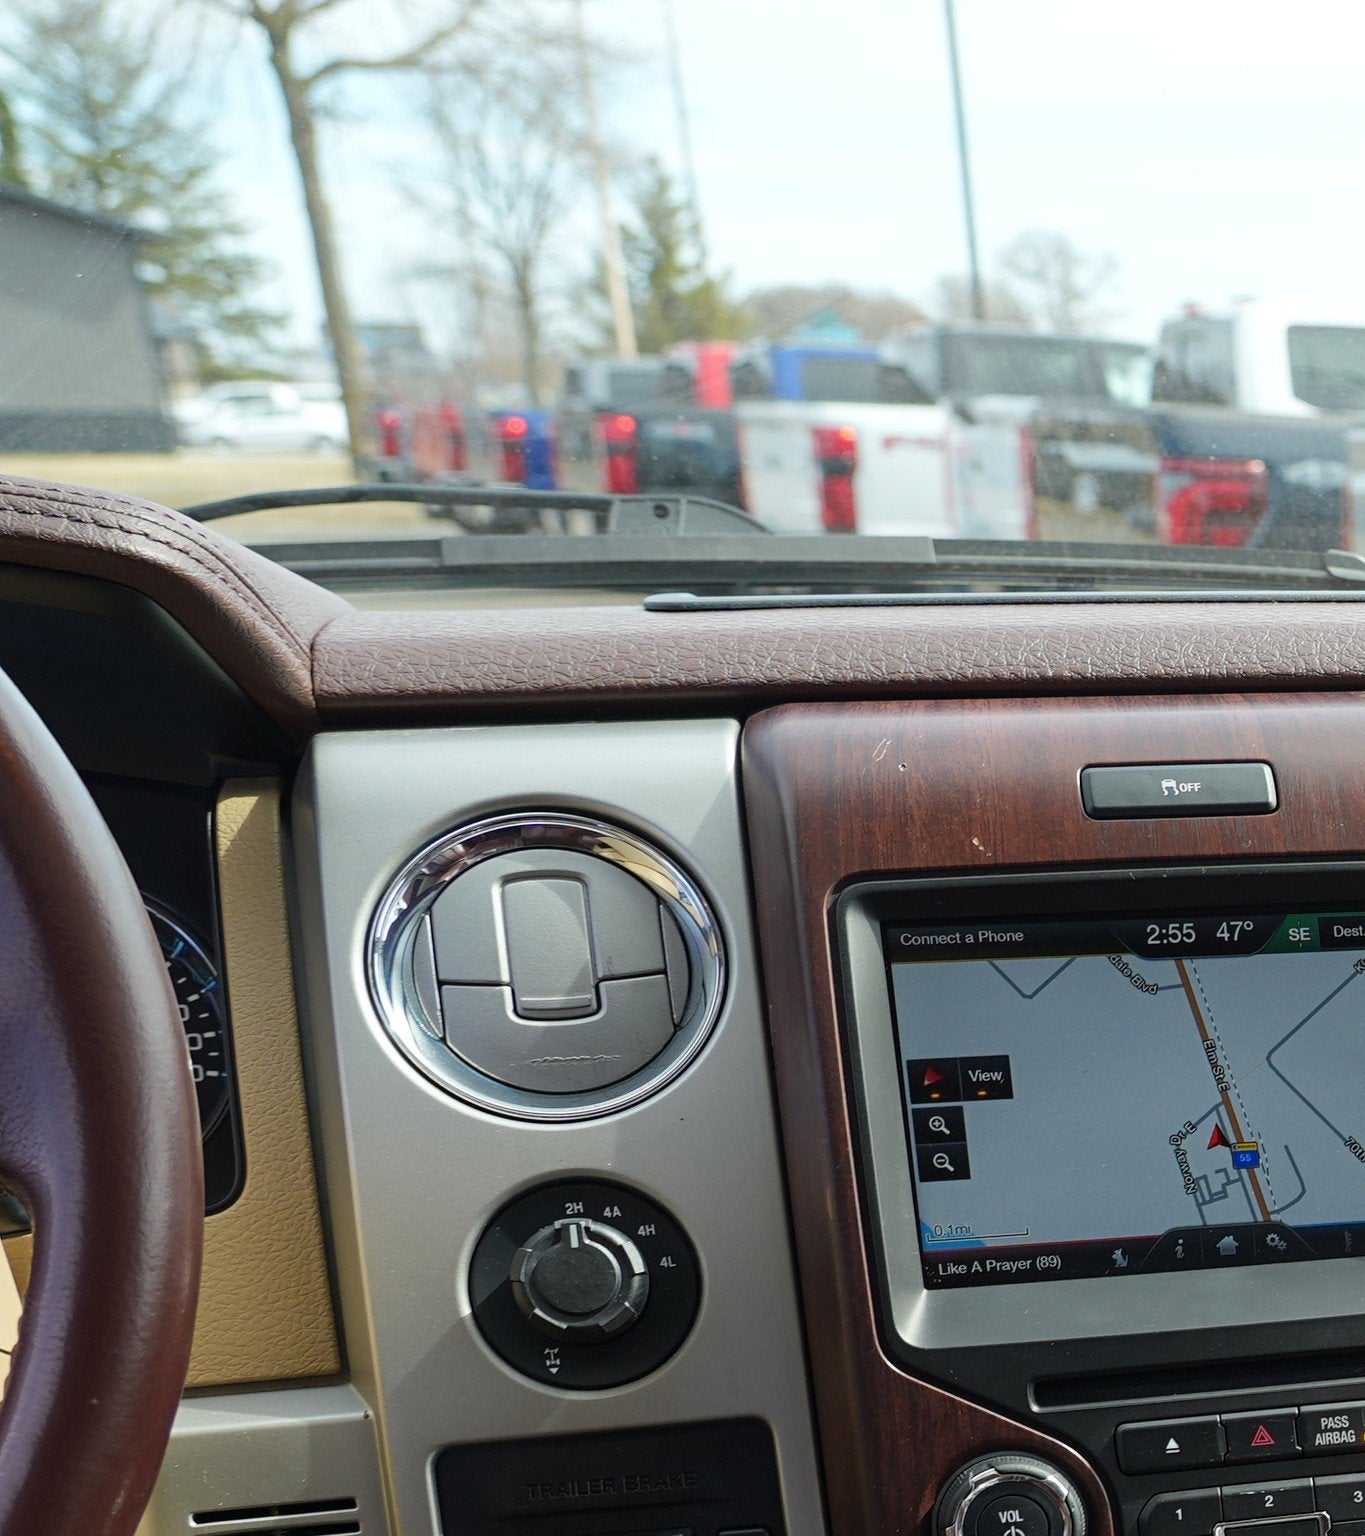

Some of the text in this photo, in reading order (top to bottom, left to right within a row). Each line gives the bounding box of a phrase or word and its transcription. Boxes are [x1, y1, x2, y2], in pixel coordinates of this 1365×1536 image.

[1179, 782, 1201, 793] OFF
[900, 930, 1024, 946] Connect a Phone
[1146, 923, 1196, 945] 2:55
[1288, 928, 1311, 942] SE
[1130, 973, 1157, 995] Blvd
[1203, 1040, 1230, 1092] Elm St E
[967, 1067, 1003, 1085] View
[1169, 1132, 1187, 1147] Dr
[1239, 1153, 1252, 1163] 55
[1174, 1148, 1198, 1196] Norway
[565, 1201, 584, 1215] 2H
[603, 1205, 622, 1218] 4A
[637, 1224, 656, 1237] 4H
[660, 1256, 676, 1268] 4L
[938, 1255, 1062, 1276] Like A Prayer (89)
[1320, 1416, 1350, 1430] PASS
[1315, 1430, 1356, 1446] AIRBAG
[524, 1470, 697, 1502] TRAILER BRAKE
[1264, 1496, 1274, 1507] 2
[1353, 1490, 1364, 1503] 3
[998, 1510, 1024, 1524] VOL
[1175, 1509, 1183, 1520] 1
